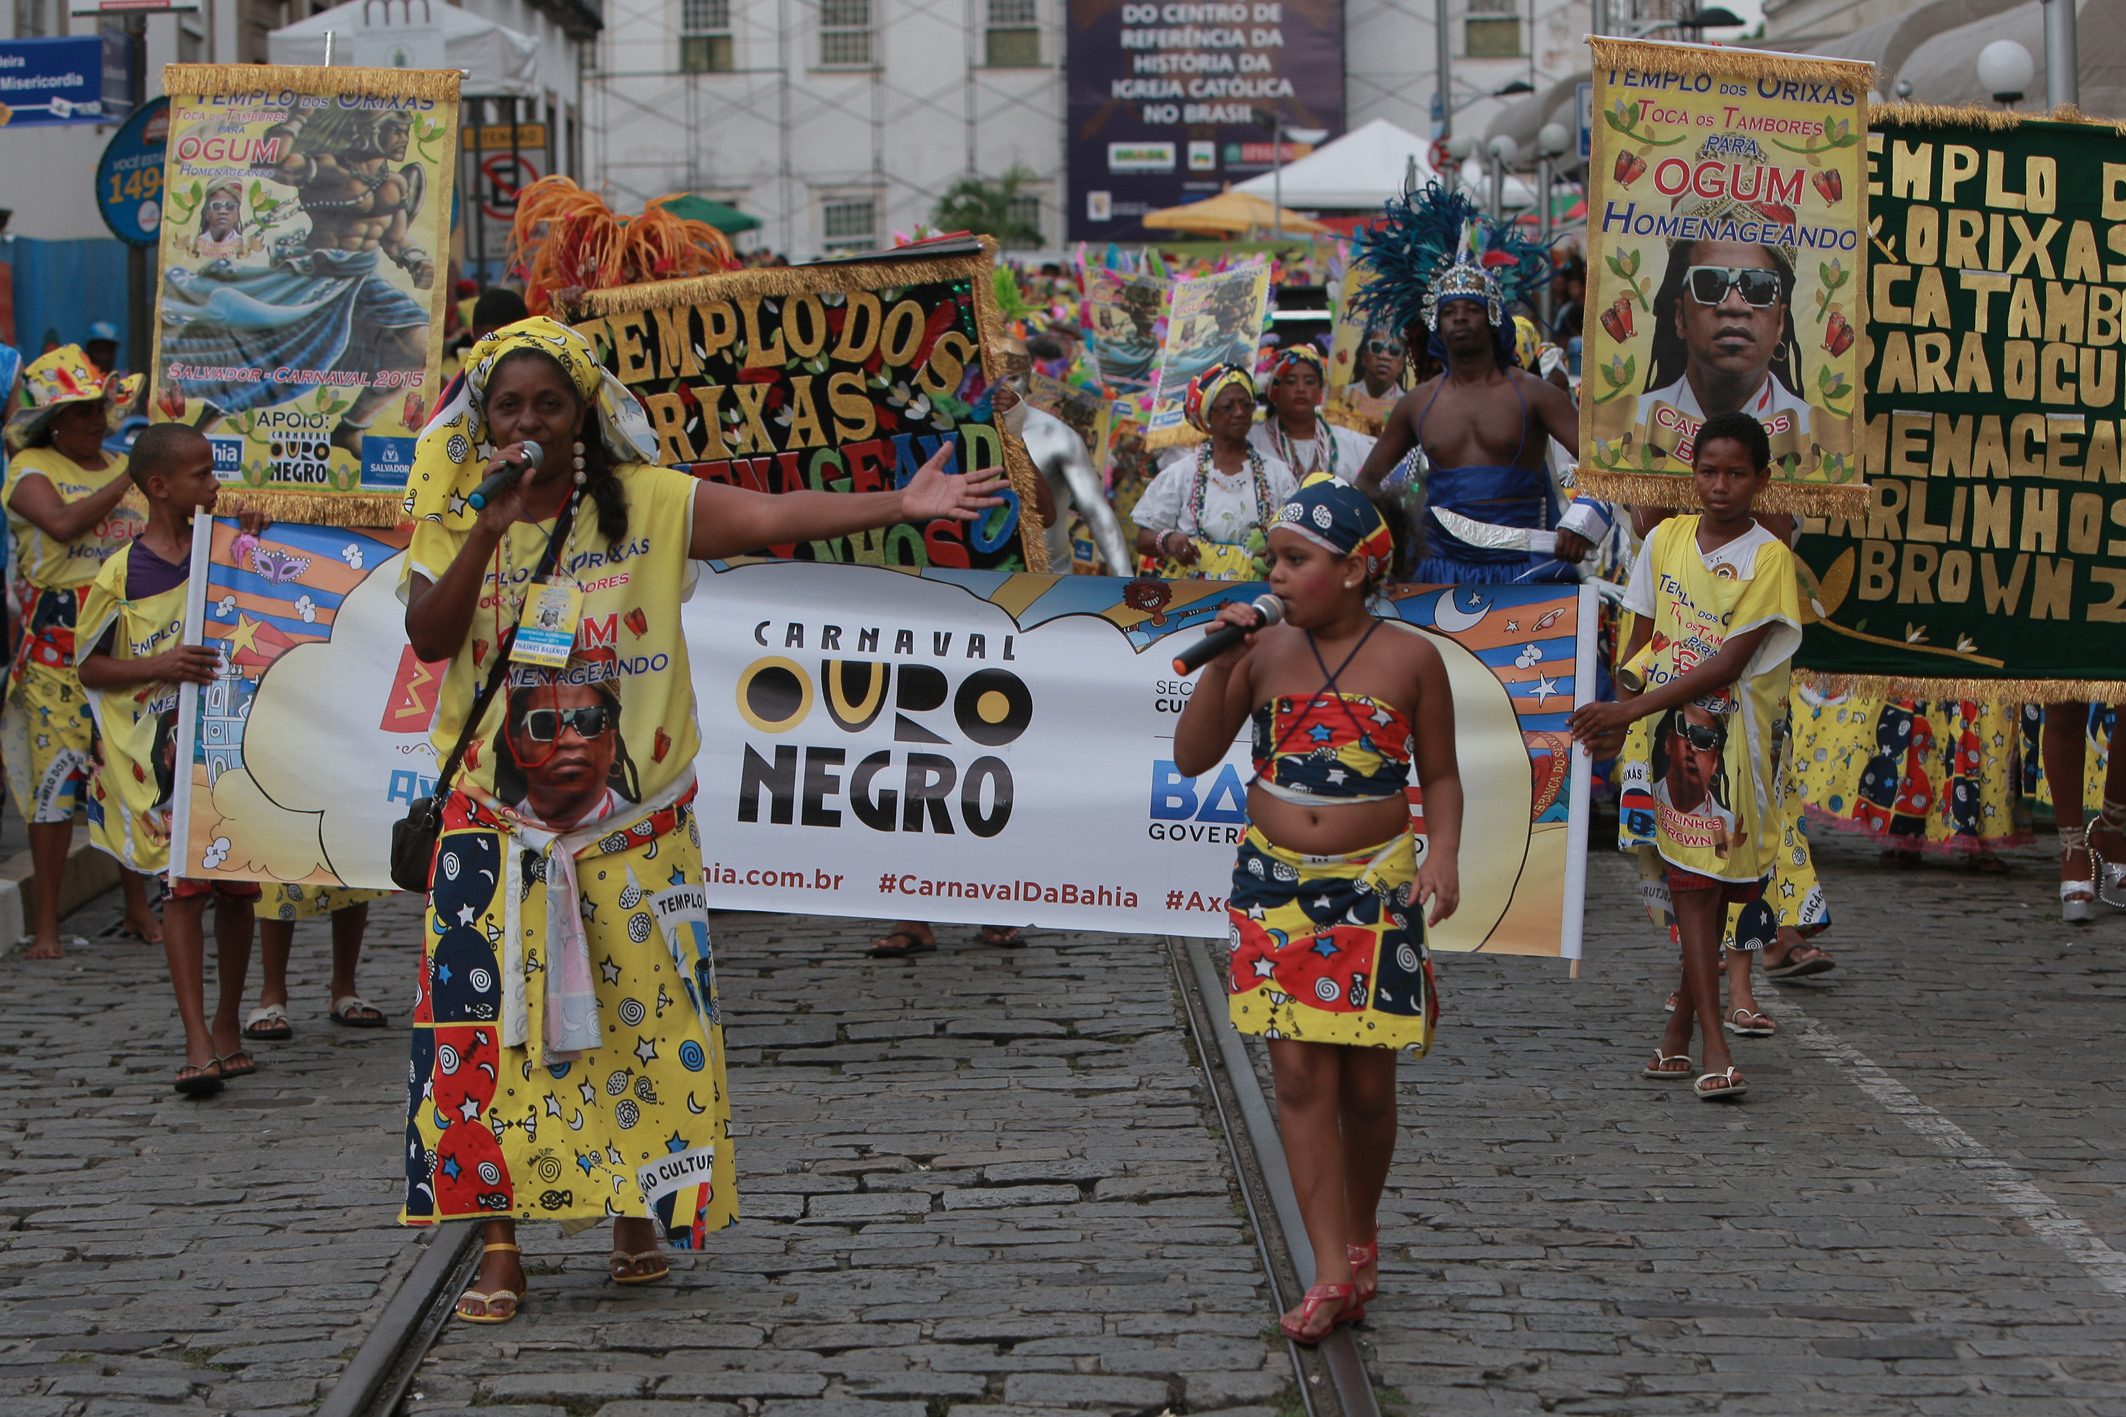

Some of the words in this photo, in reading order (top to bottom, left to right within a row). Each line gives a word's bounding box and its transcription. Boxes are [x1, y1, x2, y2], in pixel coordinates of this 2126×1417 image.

[1122, 4, 1158, 24] DO
[1162, 4, 1248, 23] CENTRO
[1252, 3, 1283, 23] DE
[1120, 25, 1246, 48] REFERÊNCIA
[1250, 28, 1284, 48] DA
[1133, 50, 1234, 74] HISTÓRIA
[1238, 54, 1272, 73] DA
[1, 72, 84, 90] Misericordia
[1111, 79, 1184, 99] IGREJA
[1188, 75, 1294, 98] CATÓLICA
[1607, 69, 1712, 94] TEMPLO
[175, 107, 206, 122] TOCA
[226, 108, 288, 123] TAMBORES
[1143, 104, 1179, 124] NO
[1183, 103, 1253, 123] BRASIL
[1637, 99, 1689, 126] TOCA
[1722, 106, 1824, 137] TAMBORES
[216, 125, 245, 135] PARA
[177, 136, 281, 164] OGUM
[1705, 135, 1758, 156] PARA
[179, 164, 276, 179] HOMENAGEANDO
[1653, 156, 1807, 207] OGUM
[1601, 200, 1857, 251] HOMENAGEANDO
[1959, 269, 2126, 347] TAMB
[167, 362, 263, 383] SALVADOR
[273, 366, 371, 387] CARNAVAL
[373, 370, 426, 388] 2015
[256, 411, 330, 430] APOIO:
[644, 368, 878, 466] RIXAS
[271, 431, 327, 441] CARNAVAL
[213, 442, 238, 462] hia
[270, 441, 330, 461] OURO
[269, 461, 327, 484] NEGRO
[1857, 539, 2075, 621] BROWN
[753, 620, 1016, 661] CARNAVAL
[735, 655, 1034, 747] OURO
[737, 740, 1015, 838] NEGRO
[1660, 817, 1712, 846] BROWN
[878, 872, 1138, 909] #CarnavalDaBahia
[658, 893, 703, 916] TEMPLO
